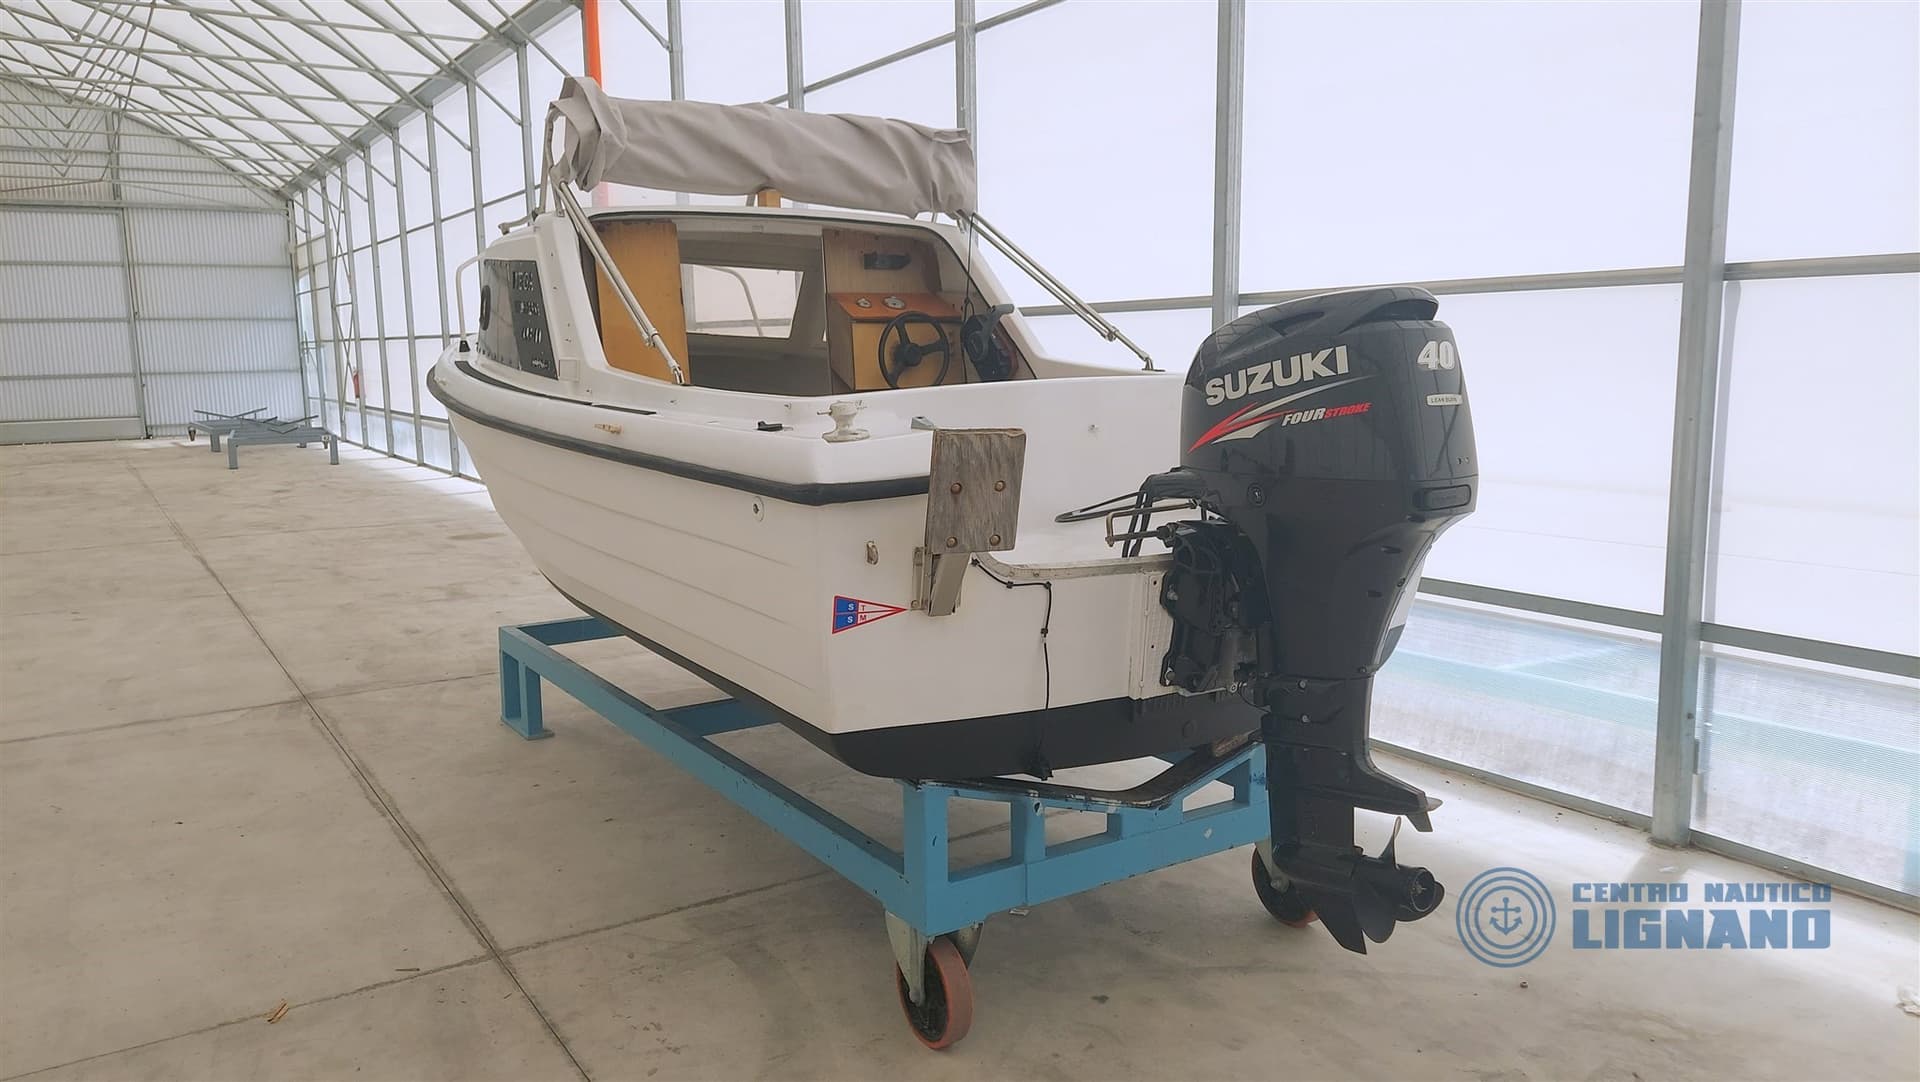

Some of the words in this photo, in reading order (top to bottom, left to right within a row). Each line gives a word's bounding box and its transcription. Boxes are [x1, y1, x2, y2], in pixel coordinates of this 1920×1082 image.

[1417, 340, 1455, 370] 40
[1205, 345, 1350, 406] SUZUKI
[859, 614, 867, 622] M
